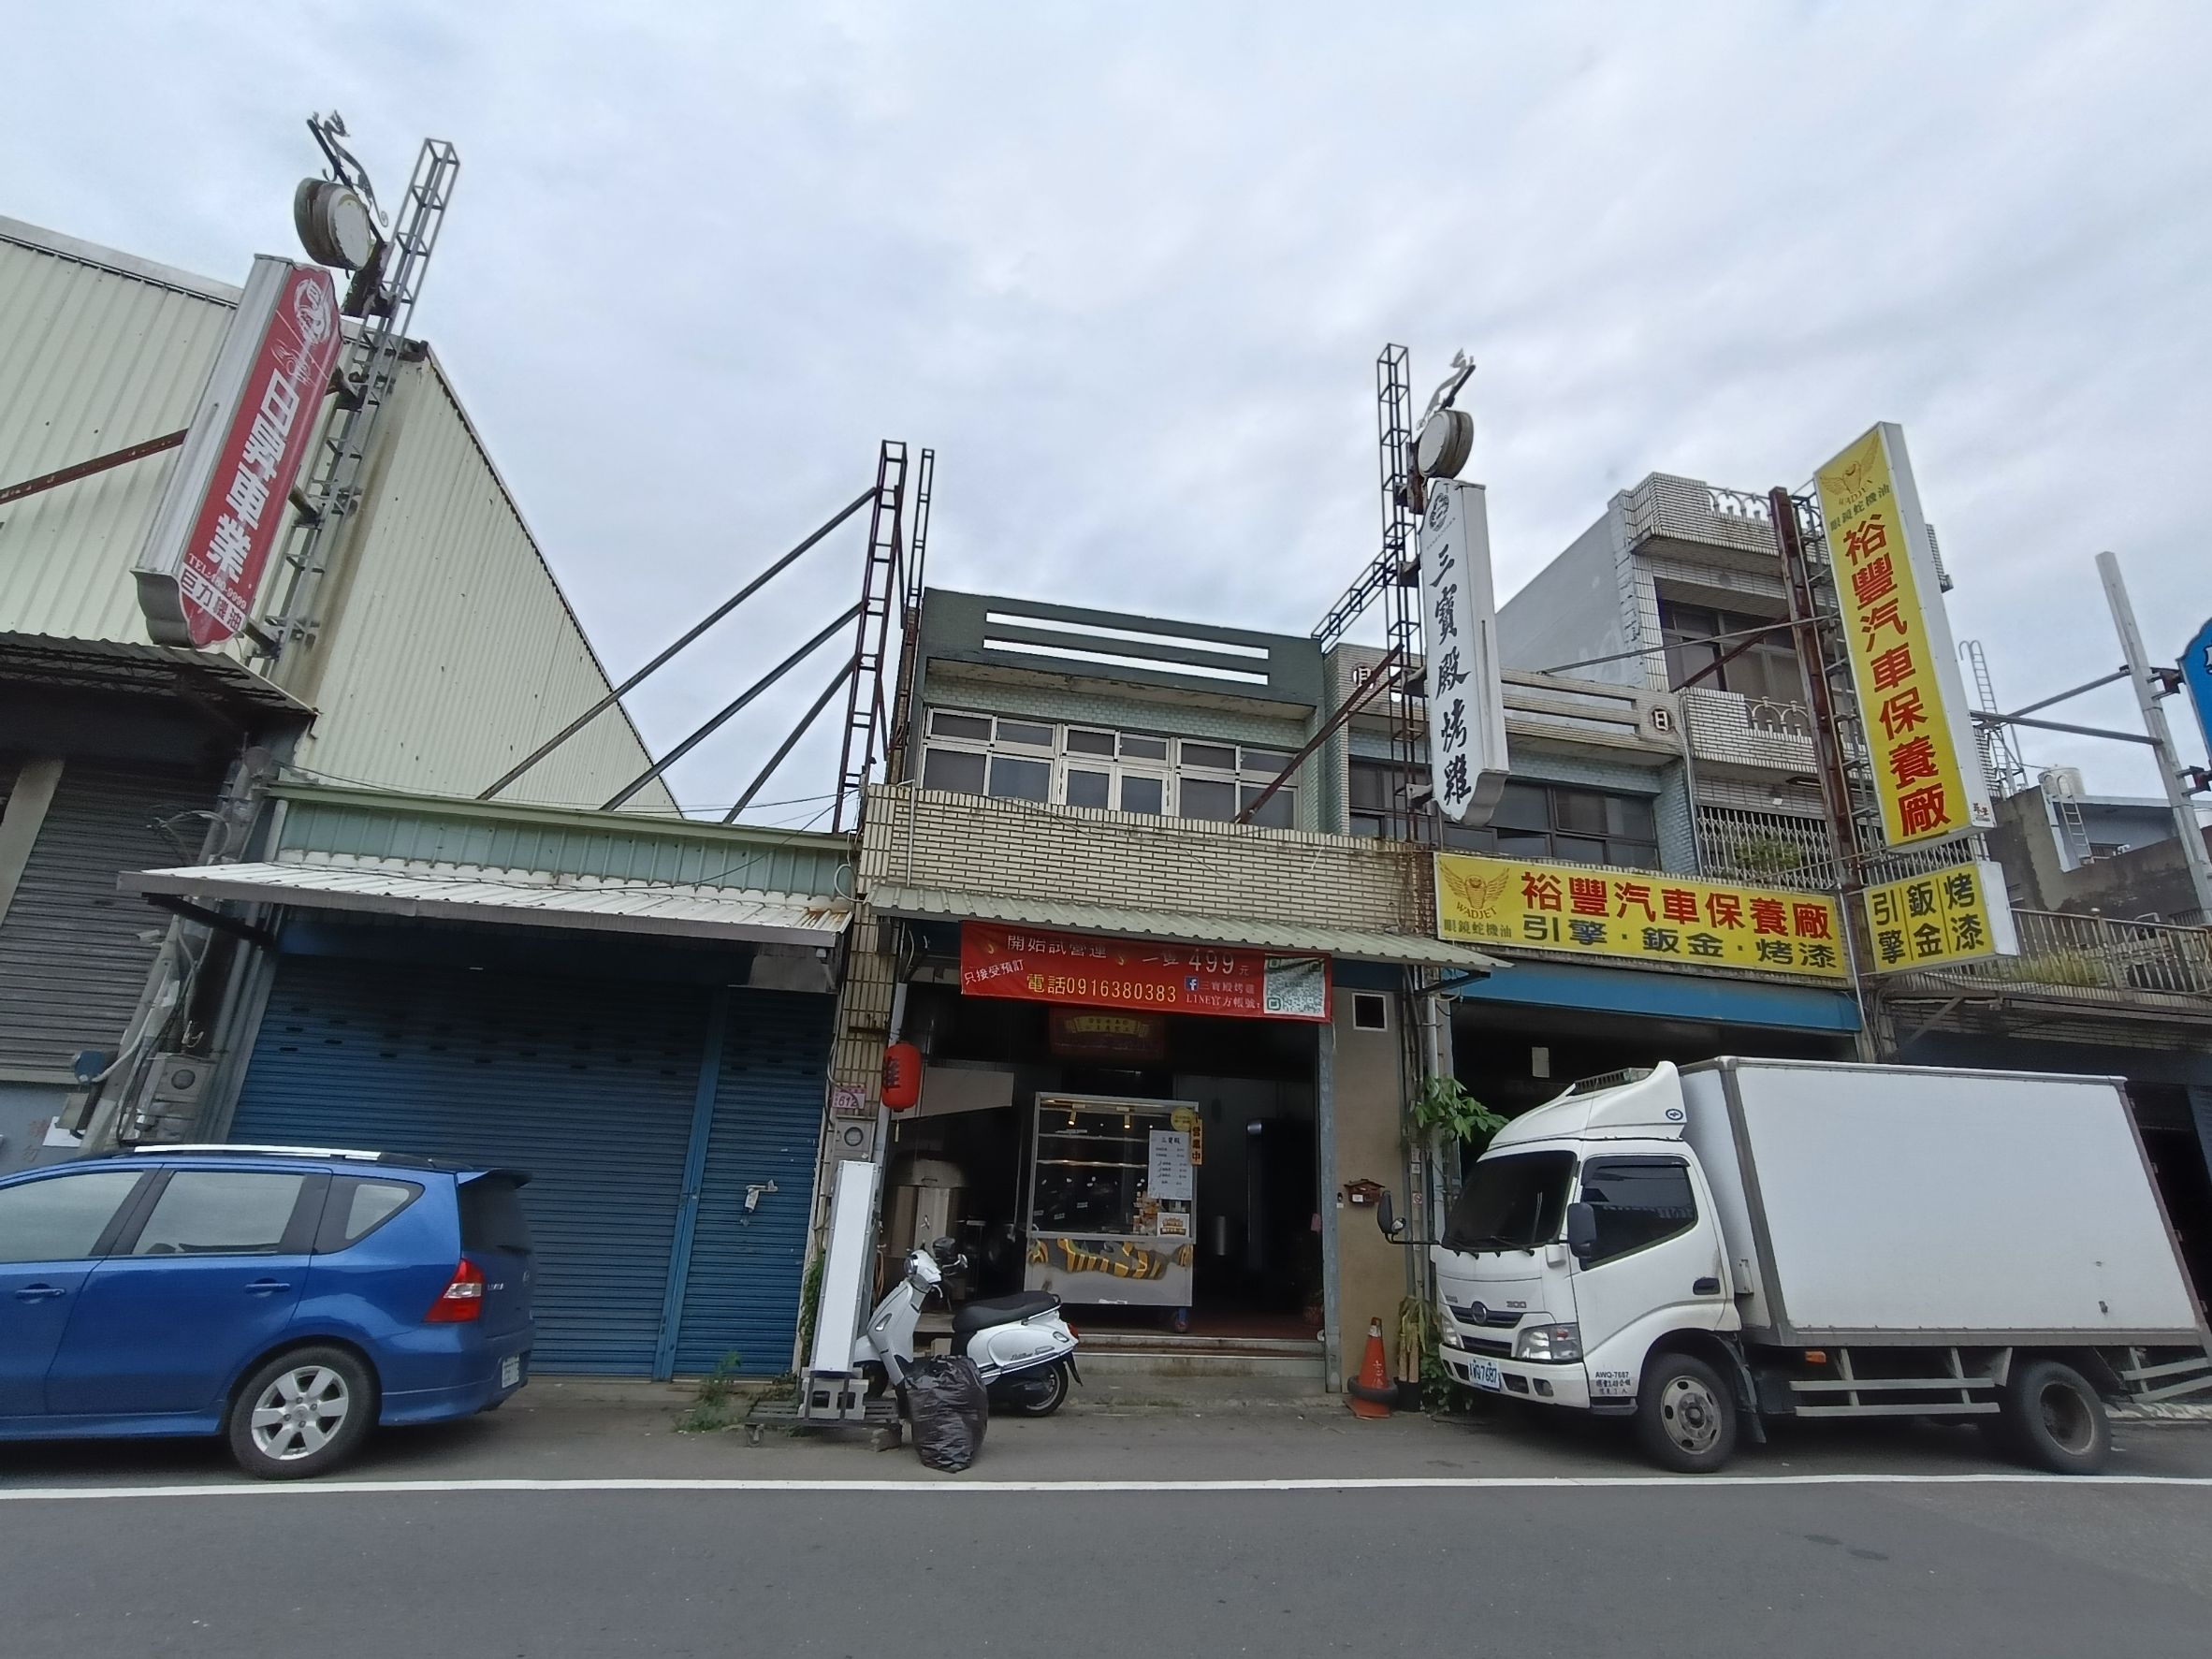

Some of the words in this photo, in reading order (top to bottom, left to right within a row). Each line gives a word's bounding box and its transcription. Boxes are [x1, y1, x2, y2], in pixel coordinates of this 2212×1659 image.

[1829, 483, 1890, 531] 眼鏡蛇機油
[180, 567, 242, 632] 巨力機油
[1430, 543, 1472, 807] 三寶殿烤雞
[1842, 513, 1952, 838] 裕豐汽車保養廠
[1444, 919, 1512, 939] 眼鏡蛇機油
[1456, 901, 1497, 920] WADJET
[1521, 870, 1834, 942] 裕豐汽車保養廠
[1871, 889, 1906, 965] 引擎
[1906, 880, 1943, 958] 鈑金
[1943, 872, 1985, 952] 烤漆
[964, 958, 1025, 985] 只接受預訂
